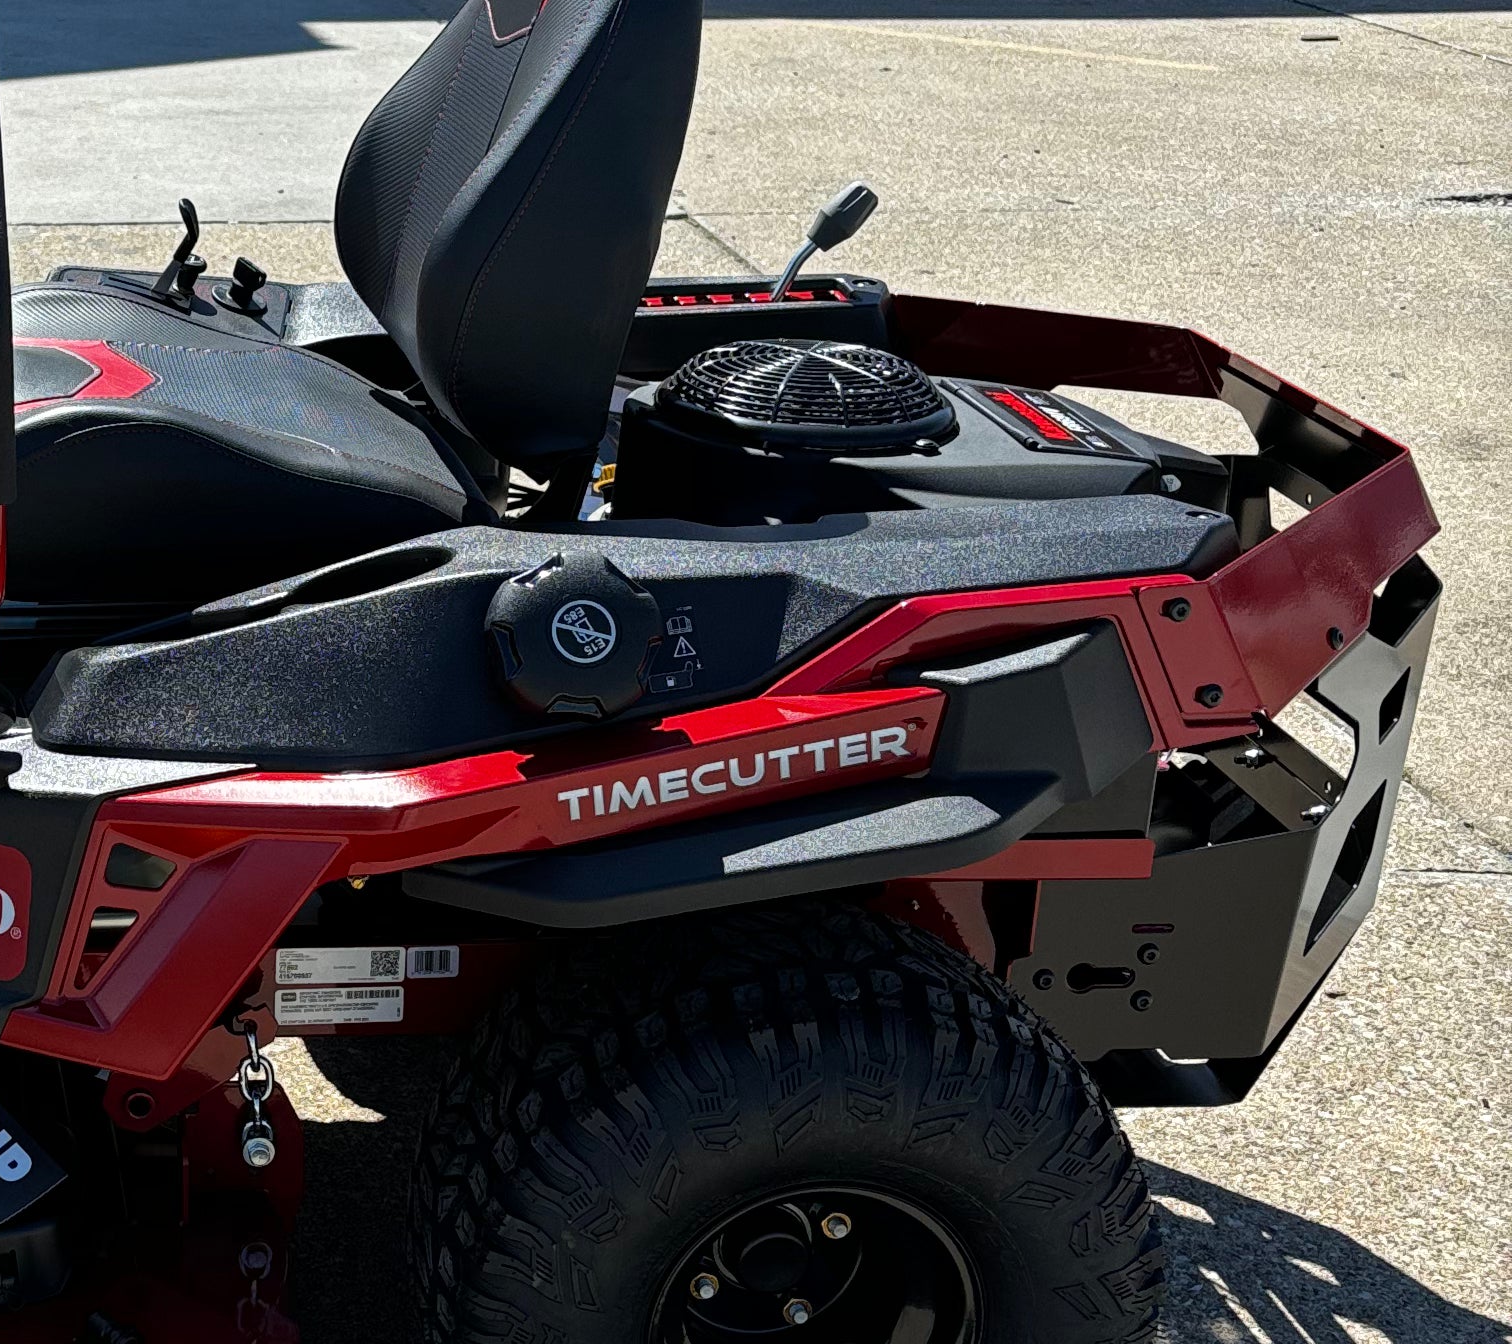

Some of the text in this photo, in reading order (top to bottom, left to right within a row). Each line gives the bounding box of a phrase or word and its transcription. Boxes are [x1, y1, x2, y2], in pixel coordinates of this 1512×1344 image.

[563, 606, 586, 624] E85
[584, 637, 606, 656] E15
[557, 726, 911, 821] TIMECUTTER
